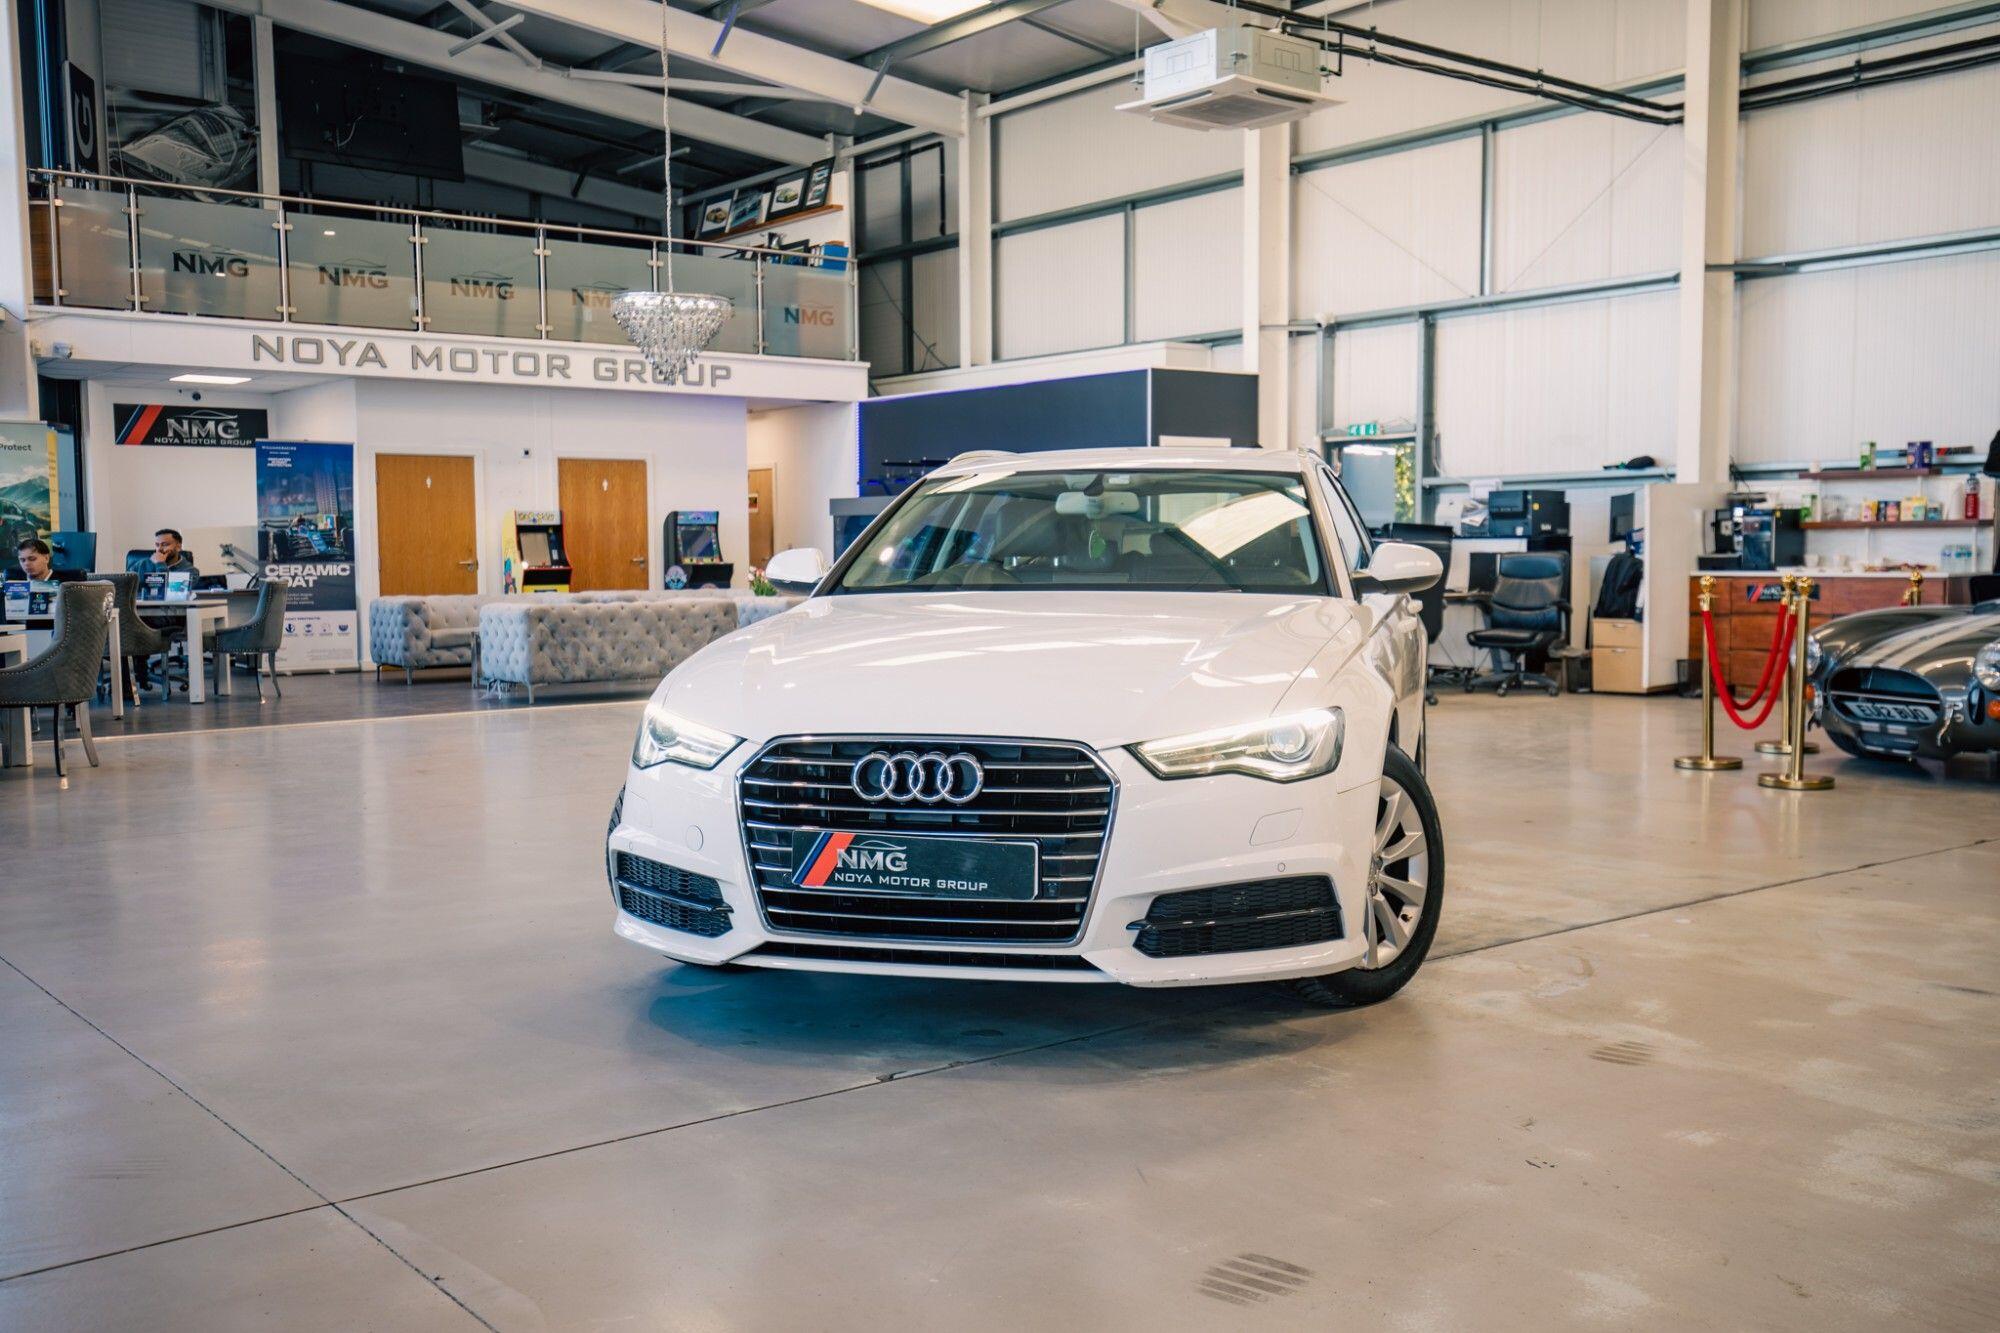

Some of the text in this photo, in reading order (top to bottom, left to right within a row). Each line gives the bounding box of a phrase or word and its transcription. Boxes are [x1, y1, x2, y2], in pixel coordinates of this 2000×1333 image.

[172, 251, 249, 278] NMG
[318, 265, 389, 289] NMG
[450, 278, 515, 300] NMG
[571, 288, 612, 308] NM
[783, 307, 835, 326] NMG
[252, 334, 387, 368] NOYA
[411, 344, 572, 379] MOTOR
[166, 418, 240, 439] NMG
[264, 564, 351, 577] CERAMIC
[836, 849, 908, 872] NMG
[834, 872, 988, 891] NOYA MOTOR GROUP
